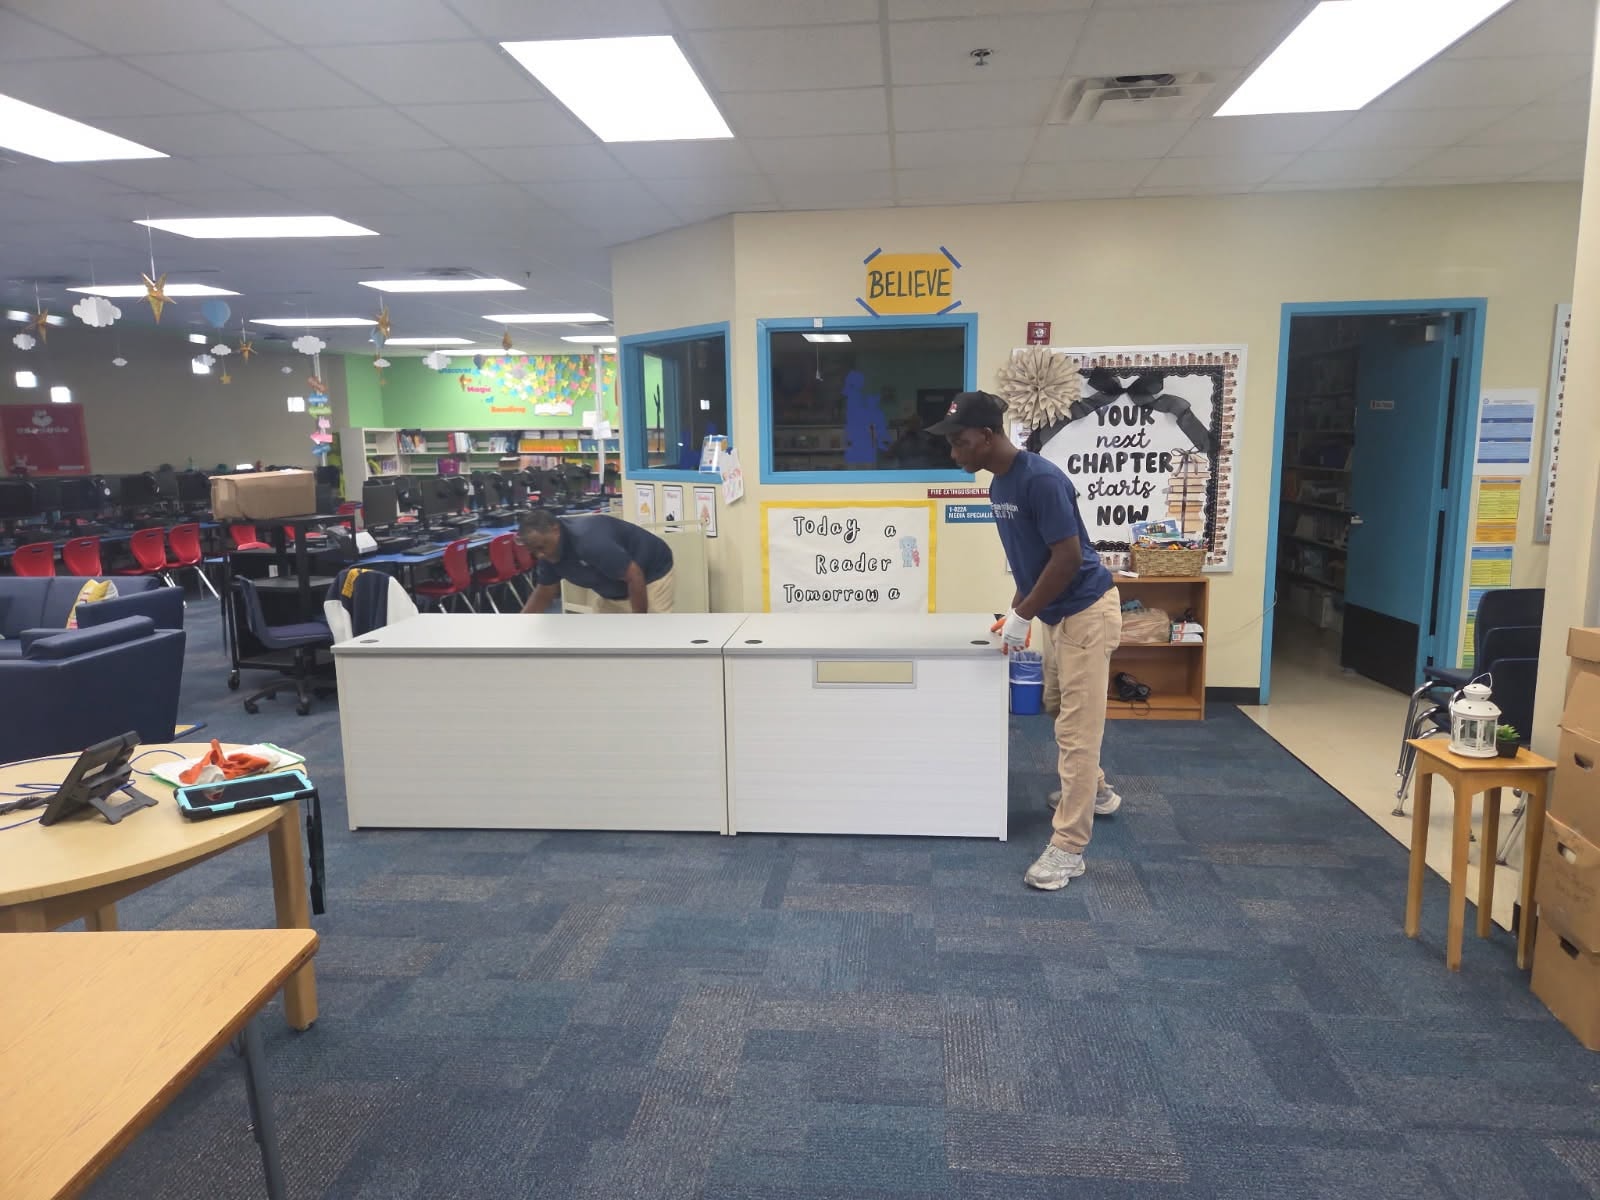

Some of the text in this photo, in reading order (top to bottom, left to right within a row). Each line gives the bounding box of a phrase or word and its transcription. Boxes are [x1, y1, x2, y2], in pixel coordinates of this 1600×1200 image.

[868, 268, 951, 299] BELIEVE
[1095, 405, 1155, 426] YOUR
[1096, 428, 1151, 448] next
[1067, 452, 1174, 474] CHAPTER
[1088, 475, 1156, 500] starts
[1096, 505, 1149, 526] NOW
[793, 515, 896, 543] Today a
[816, 552, 891, 574] Reader
[783, 584, 900, 603] Tomorrow a
